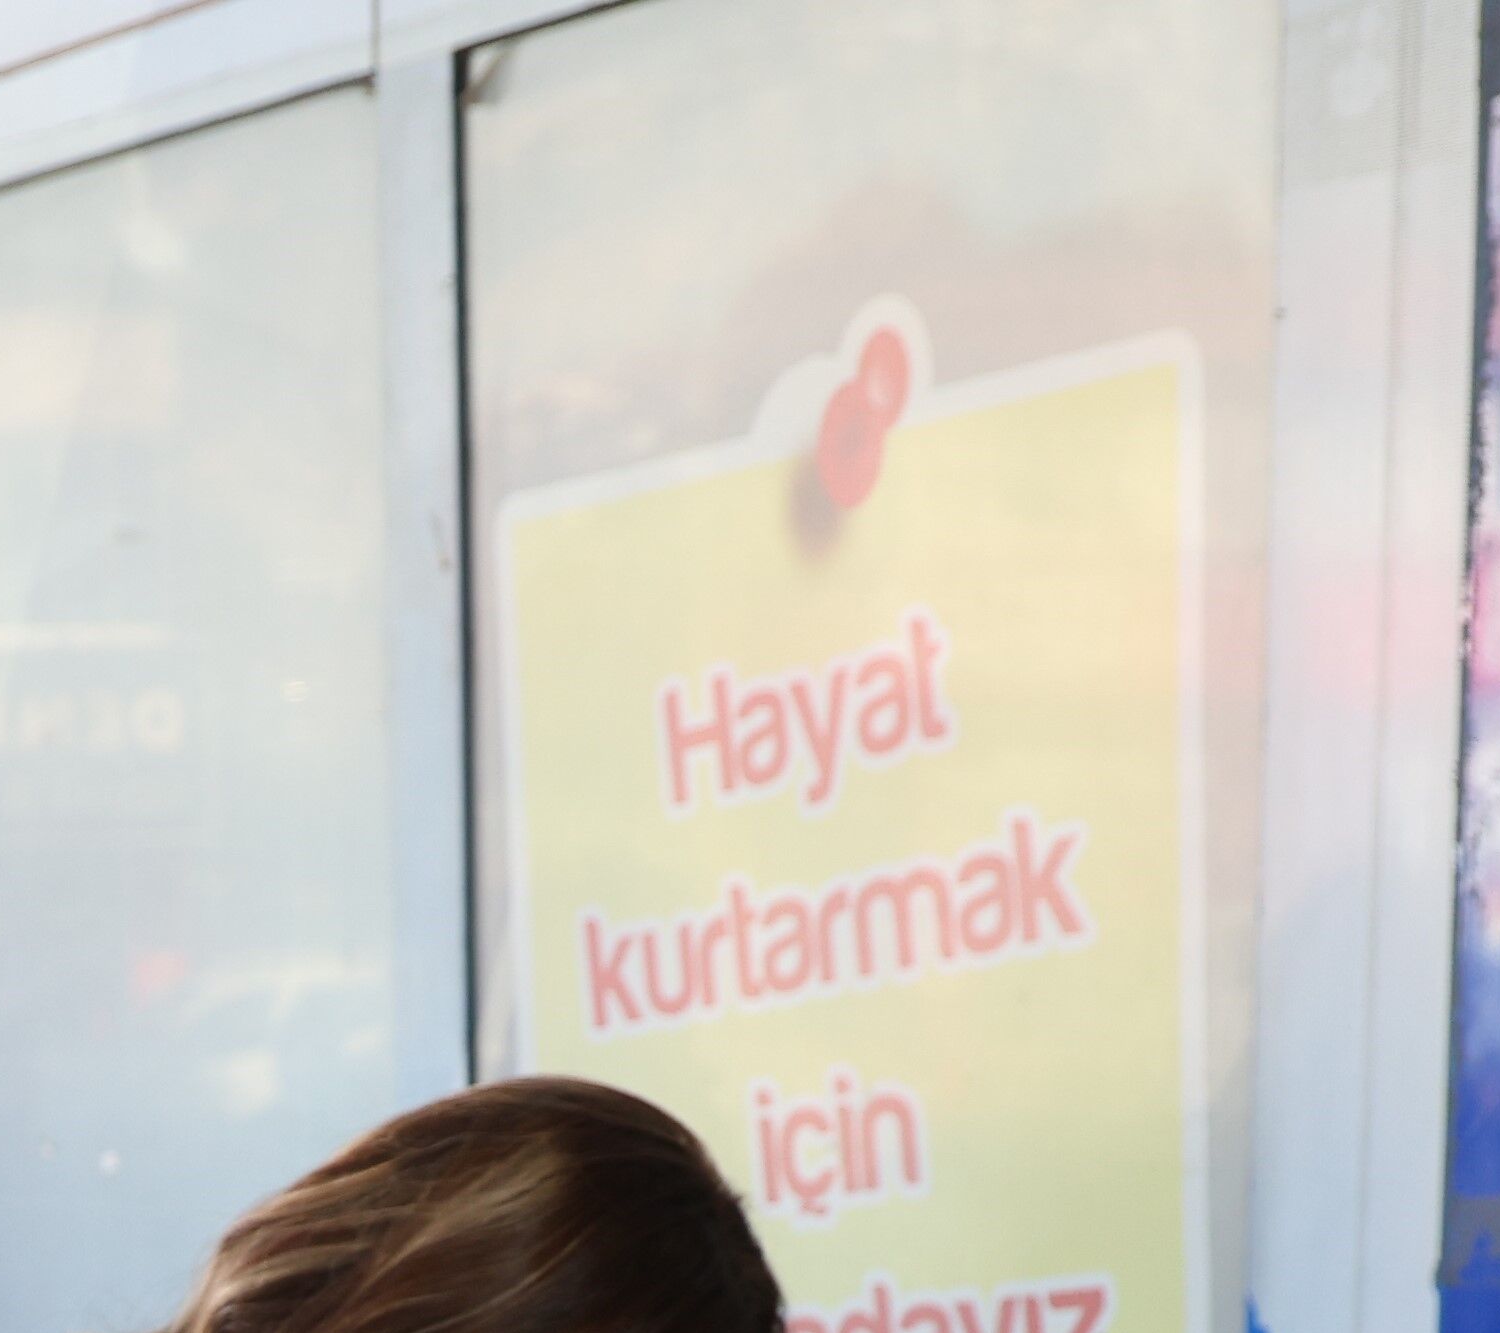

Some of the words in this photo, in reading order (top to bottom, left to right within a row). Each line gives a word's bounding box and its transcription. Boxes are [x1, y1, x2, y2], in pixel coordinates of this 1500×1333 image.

[663, 618, 948, 808] Hayat
[585, 814, 1083, 1029] kurtarmak
[755, 1073, 922, 1218] için
